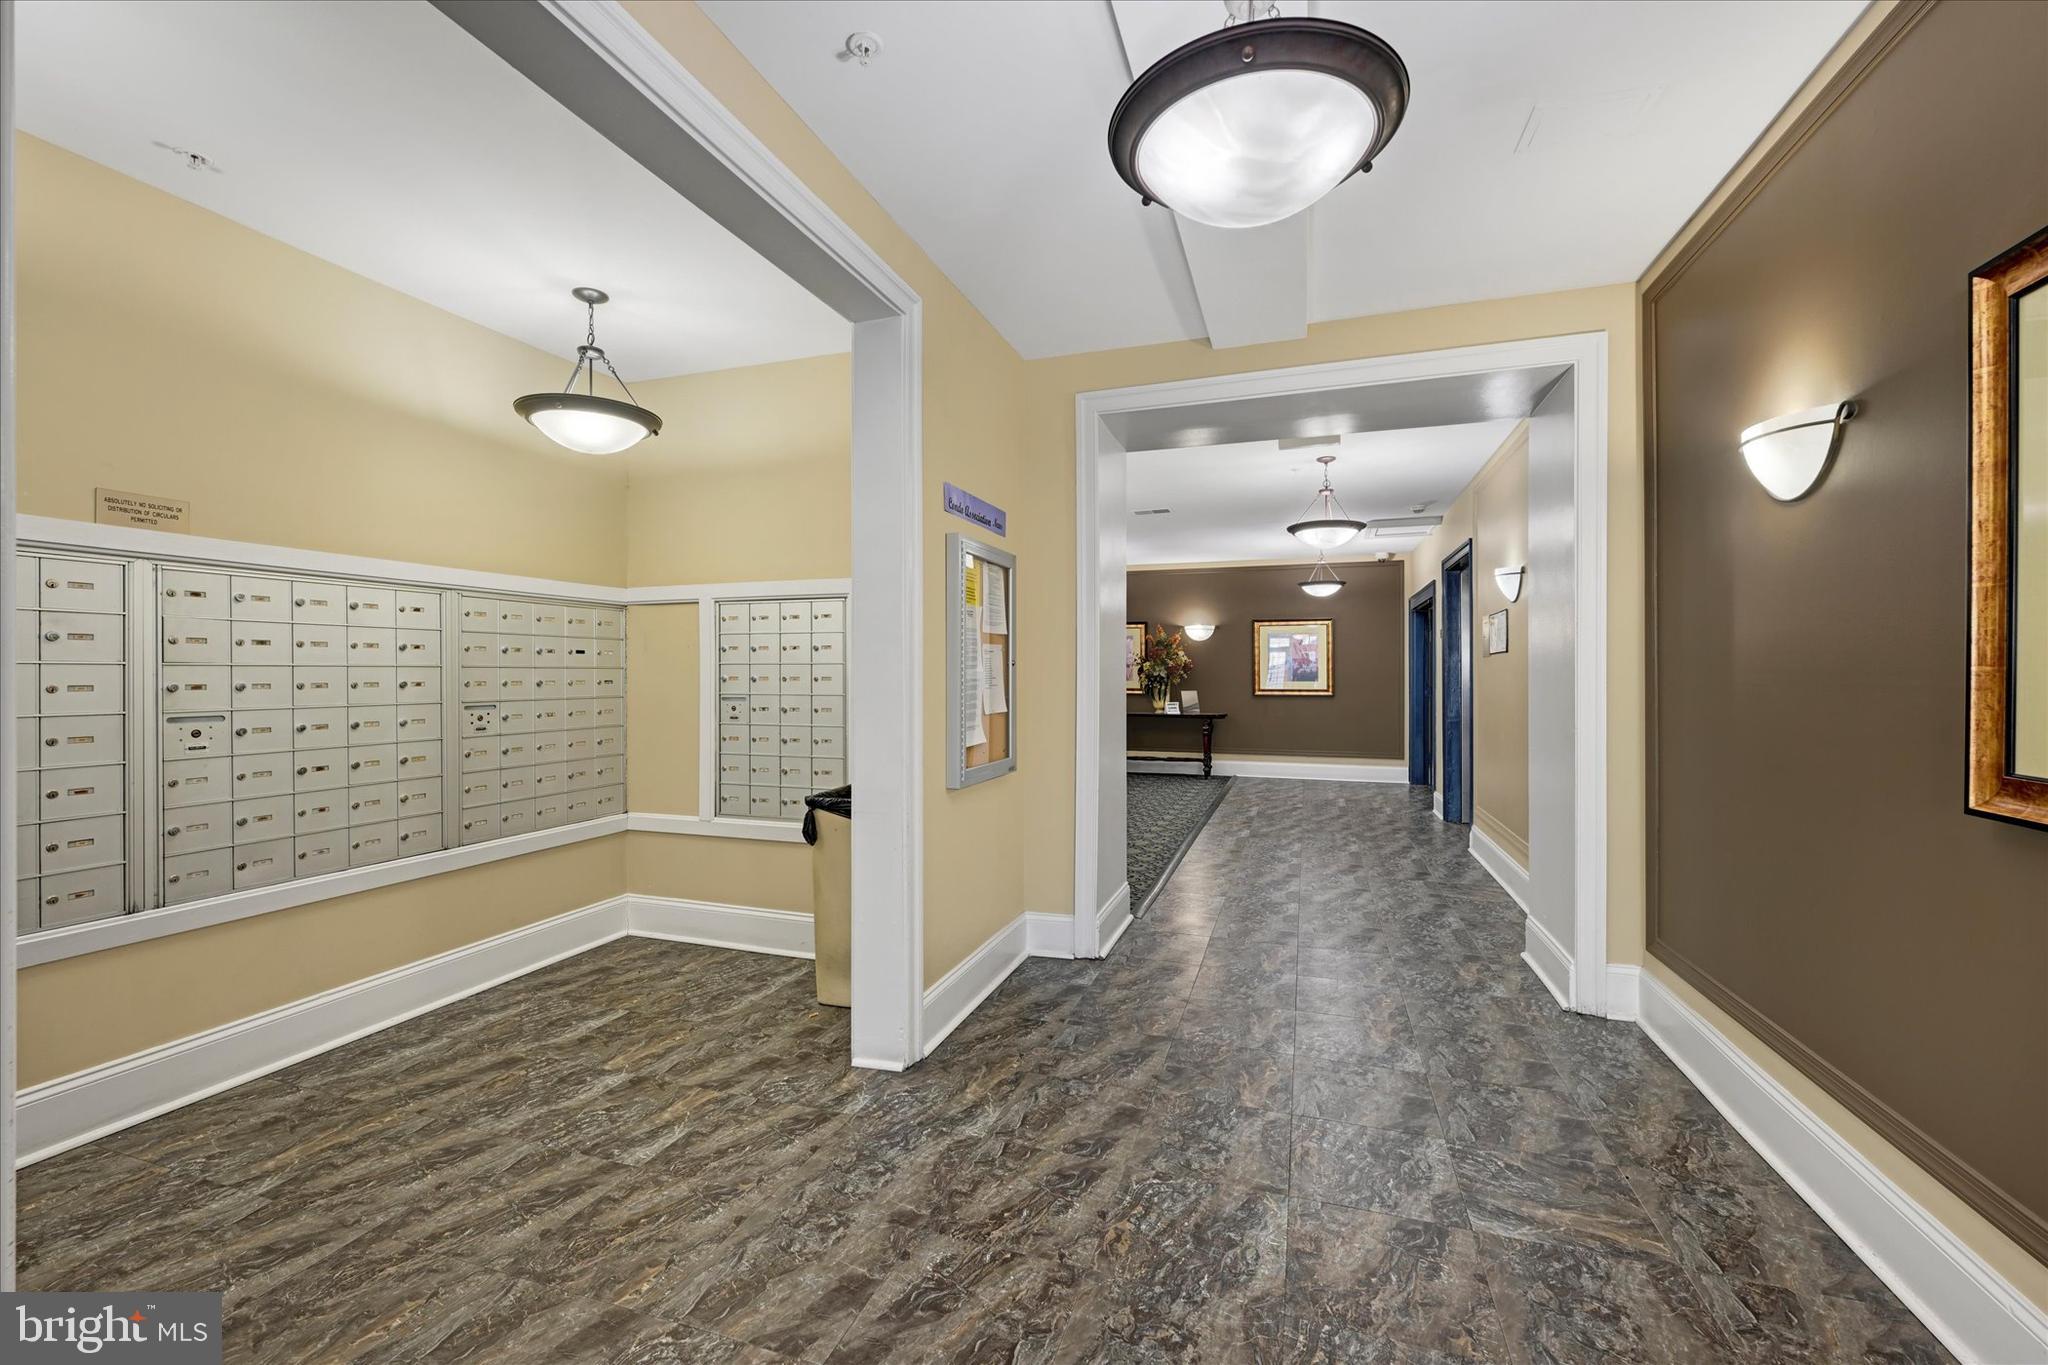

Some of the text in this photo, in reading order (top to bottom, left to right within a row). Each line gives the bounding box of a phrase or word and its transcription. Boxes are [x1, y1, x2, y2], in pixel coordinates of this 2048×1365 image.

[104, 496, 137, 507] ABSOLUTELY
[148, 503, 174, 512] SOLICITING
[107, 505, 142, 515] DISTRIBUTION
[152, 511, 179, 521] CIRCULARS
[130, 516, 158, 525] PERMITTED
